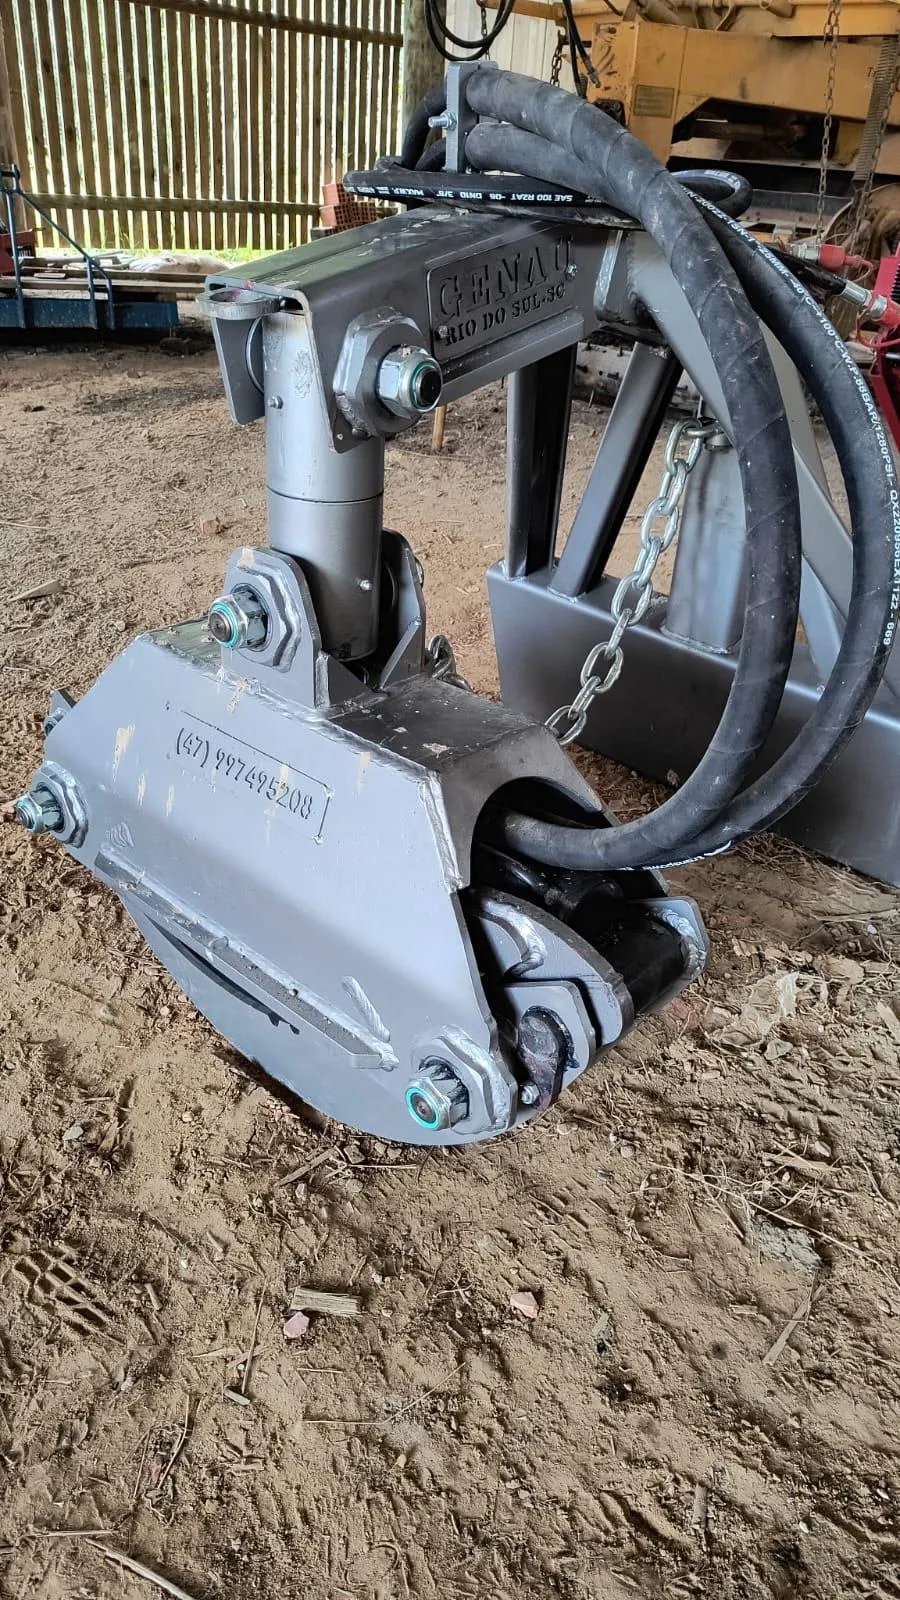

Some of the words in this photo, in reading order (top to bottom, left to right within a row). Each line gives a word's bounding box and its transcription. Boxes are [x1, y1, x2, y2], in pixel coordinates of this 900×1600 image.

[460, 191, 482, 199] DN10
[511, 193, 534, 201] R2AT
[536, 193, 552, 201] 100
[554, 194, 573, 202] SAE
[440, 234, 573, 318] GENAU
[445, 319, 477, 346] RIO
[482, 307, 506, 331] DO
[511, 281, 566, 318] SUL-SC
[883, 622, 894, 646] 669
[176, 727, 210, 768] (47)
[215, 748, 313, 820] 997495208
